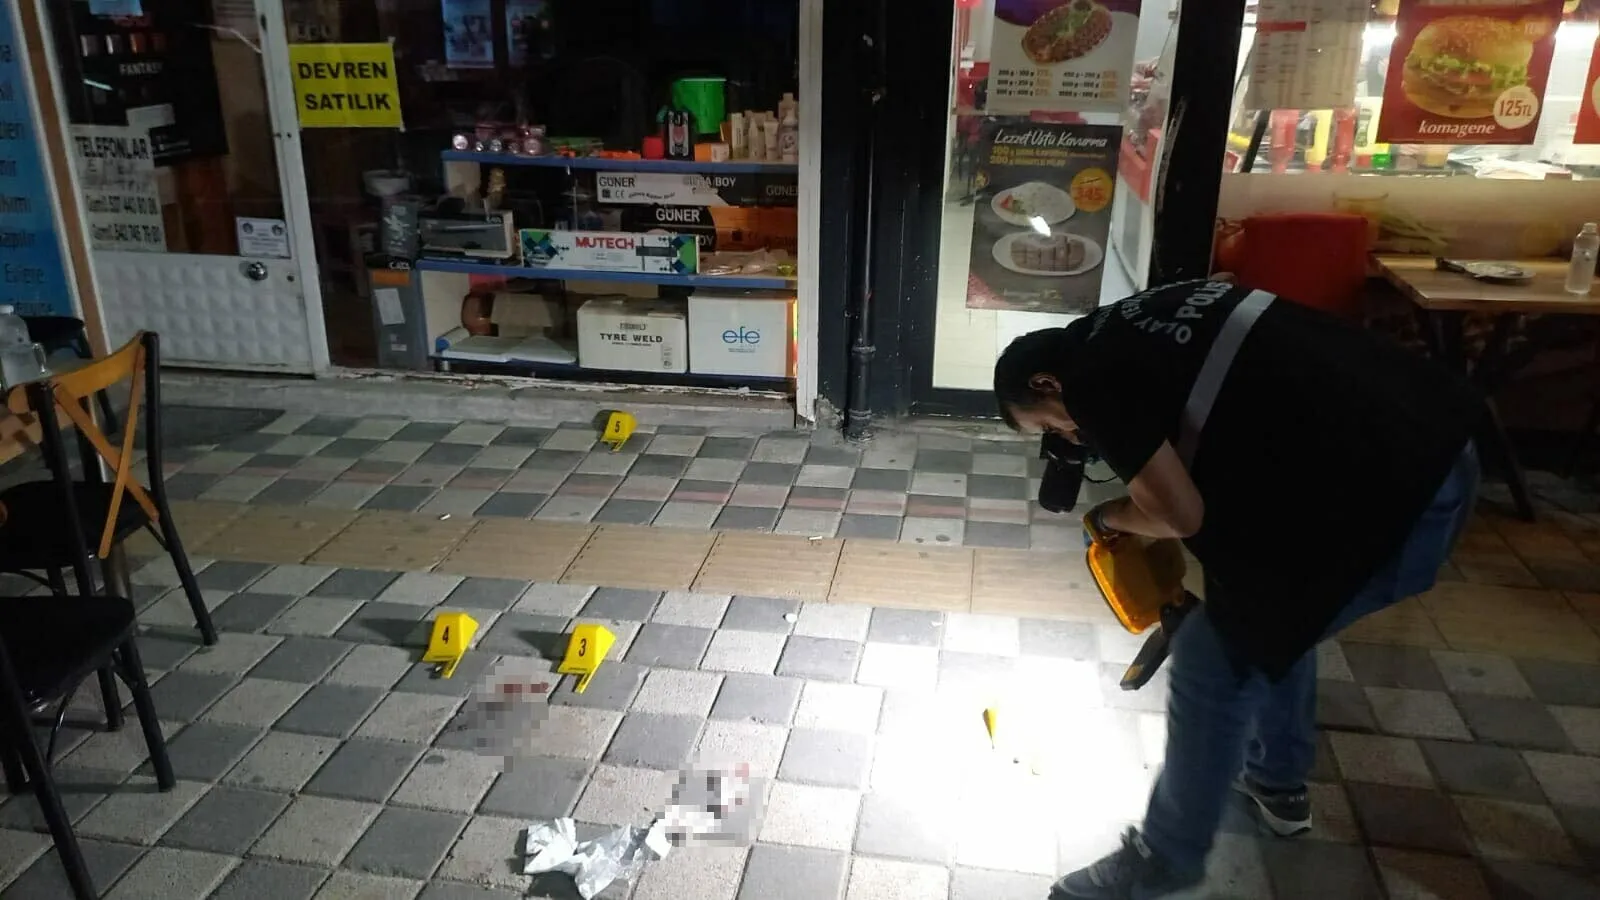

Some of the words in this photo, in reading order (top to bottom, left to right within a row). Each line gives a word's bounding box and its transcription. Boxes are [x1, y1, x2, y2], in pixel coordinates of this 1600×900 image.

[297, 62, 388, 79] DEVREN
[305, 93, 392, 111] SATILIK
[1499, 100, 1532, 117] 125TL
[994, 128, 1032, 146] Lezzet
[1418, 119, 1496, 138] komagene
[75, 136, 150, 159] TELEFONLAR
[599, 176, 635, 187] GÜNER
[715, 176, 737, 187] BOY
[655, 206, 700, 223] GÜNER
[575, 236, 635, 250] MUTECH
[600, 332, 628, 342] TYRE
[633, 334, 663, 343] WELD
[722, 326, 760, 344] efe
[614, 420, 621, 433] 5
[442, 625, 449, 645] 4
[578, 638, 587, 657] 3
